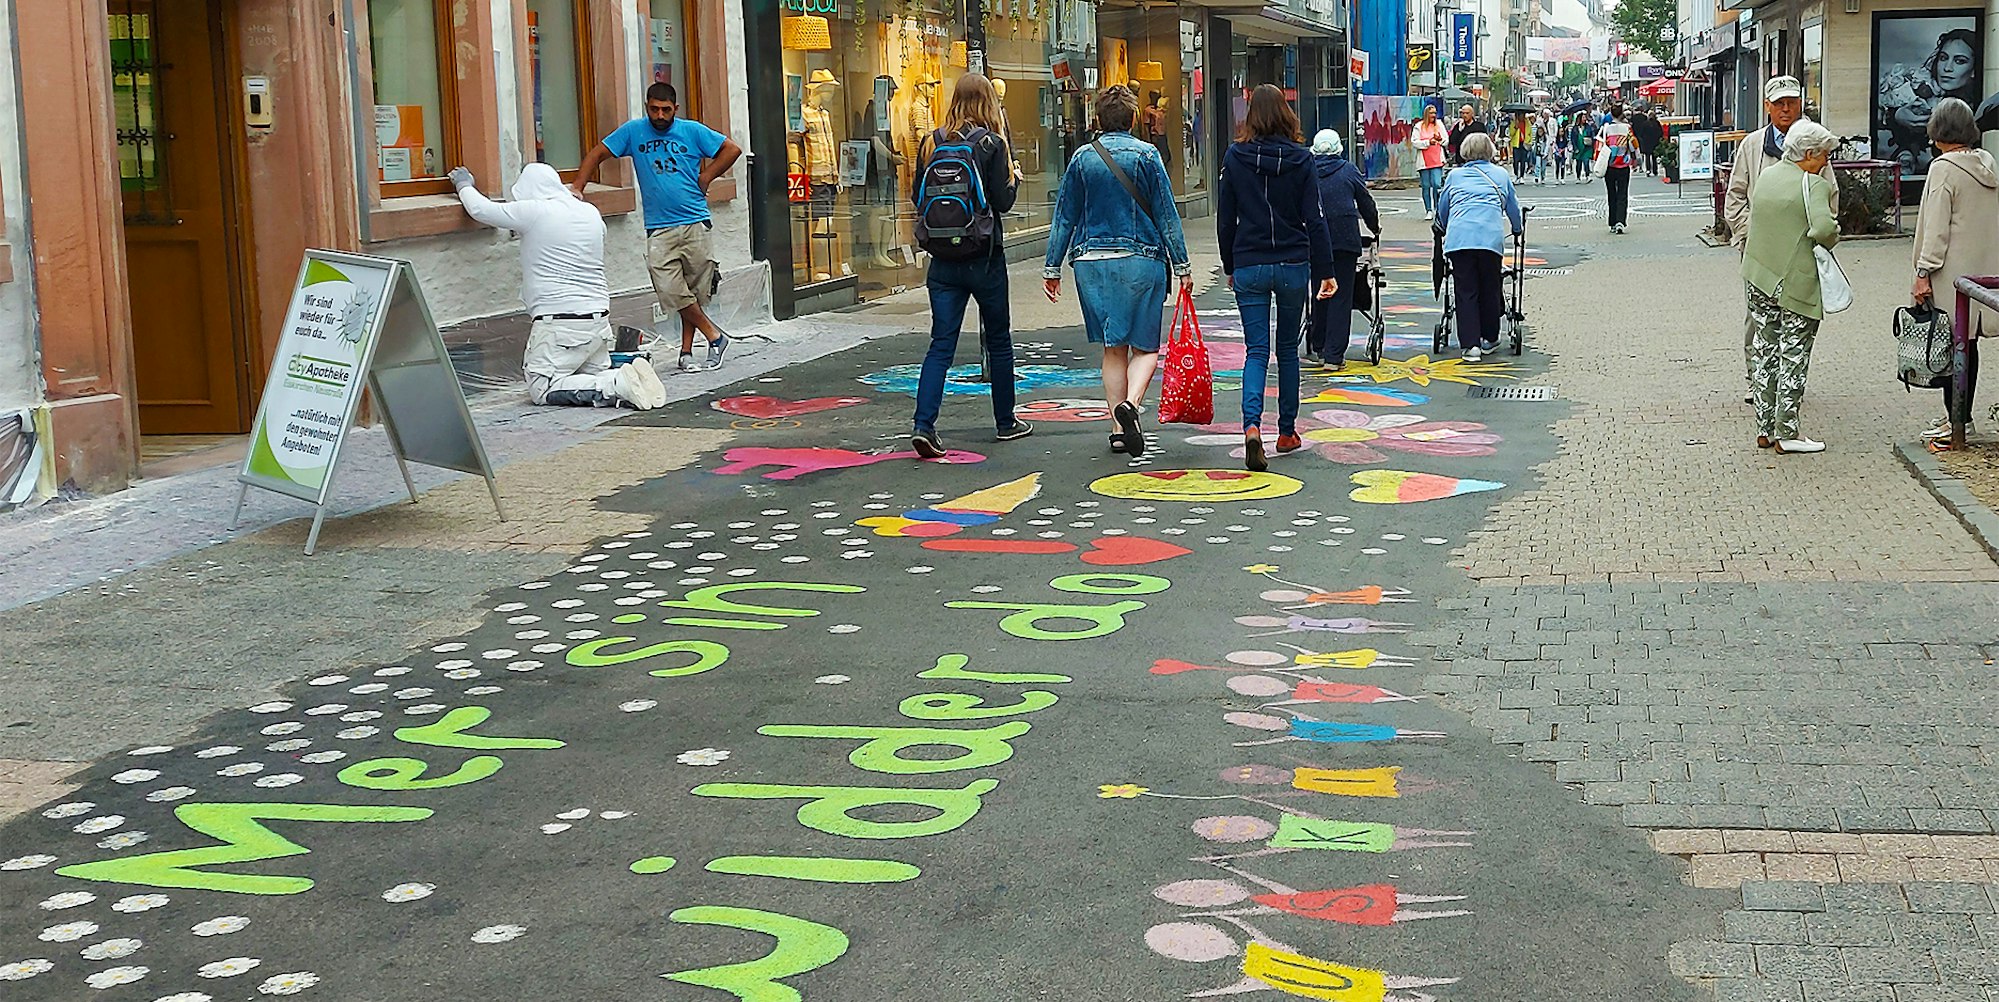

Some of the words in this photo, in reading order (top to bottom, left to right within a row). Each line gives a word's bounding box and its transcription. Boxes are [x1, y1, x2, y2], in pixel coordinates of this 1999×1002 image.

[1458, 26, 1468, 58] Thalia
[1664, 69, 1686, 78] ONLY
[304, 294, 317, 306] Wir
[316, 296, 334, 309] sind
[299, 309, 324, 323] wieder
[324, 312, 336, 324] für
[295, 326, 312, 337] euch
[328, 414, 341, 426] mit
[286, 421, 300, 434] den
[299, 425, 339, 442] gewohnten
[56, 704, 567, 895] Mer
